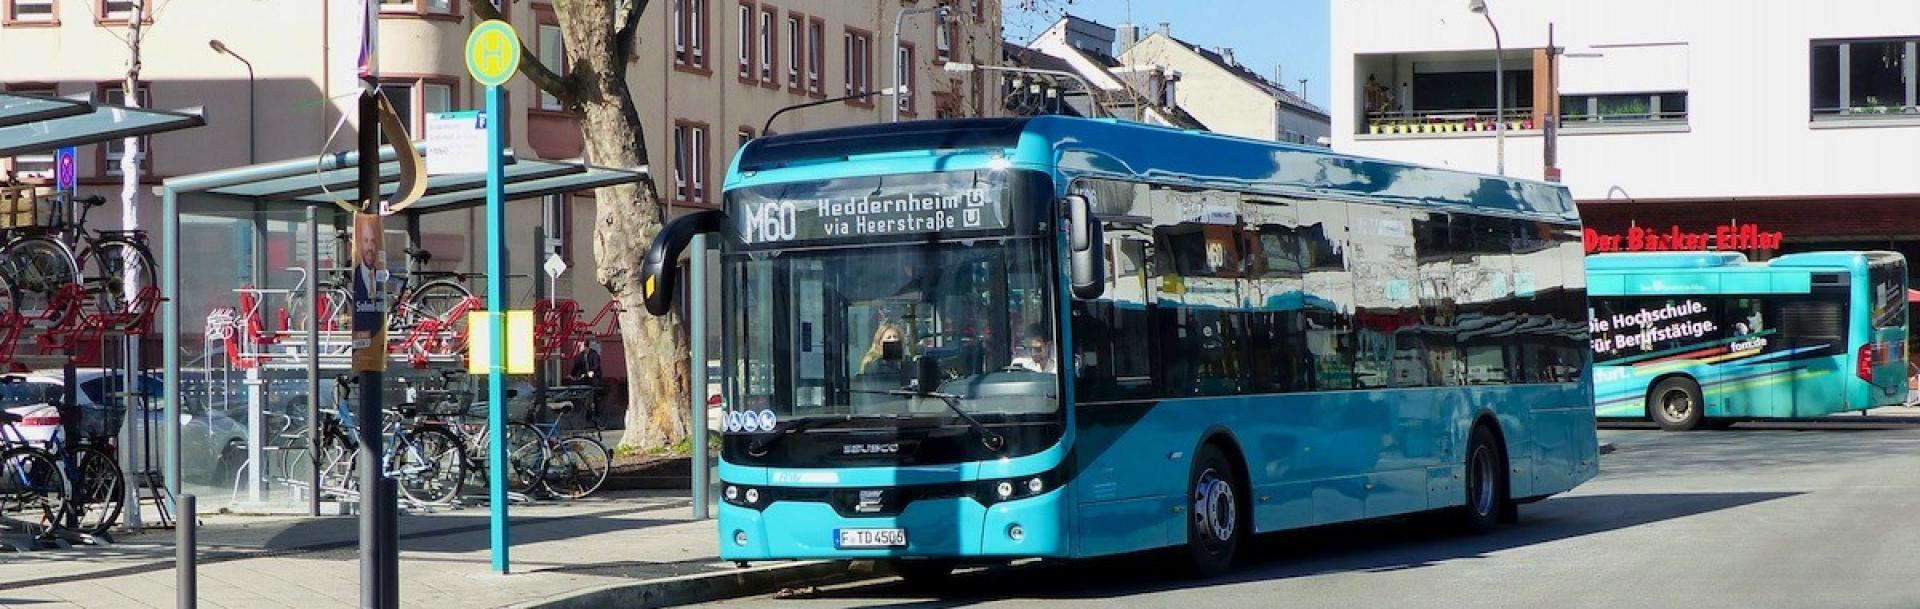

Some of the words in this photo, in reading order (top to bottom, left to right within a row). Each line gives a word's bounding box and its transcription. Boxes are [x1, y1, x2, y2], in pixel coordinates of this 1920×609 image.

[818, 193, 959, 217] Heddernheim
[746, 201, 796, 243] M60
[824, 218, 849, 235] via
[857, 211, 955, 233] Heerstraße
[1584, 228, 1621, 251] Der
[1716, 223, 1783, 250] Eifler
[1612, 299, 1708, 329] Hochschule.
[1615, 320, 1718, 349] Berufstätige.
